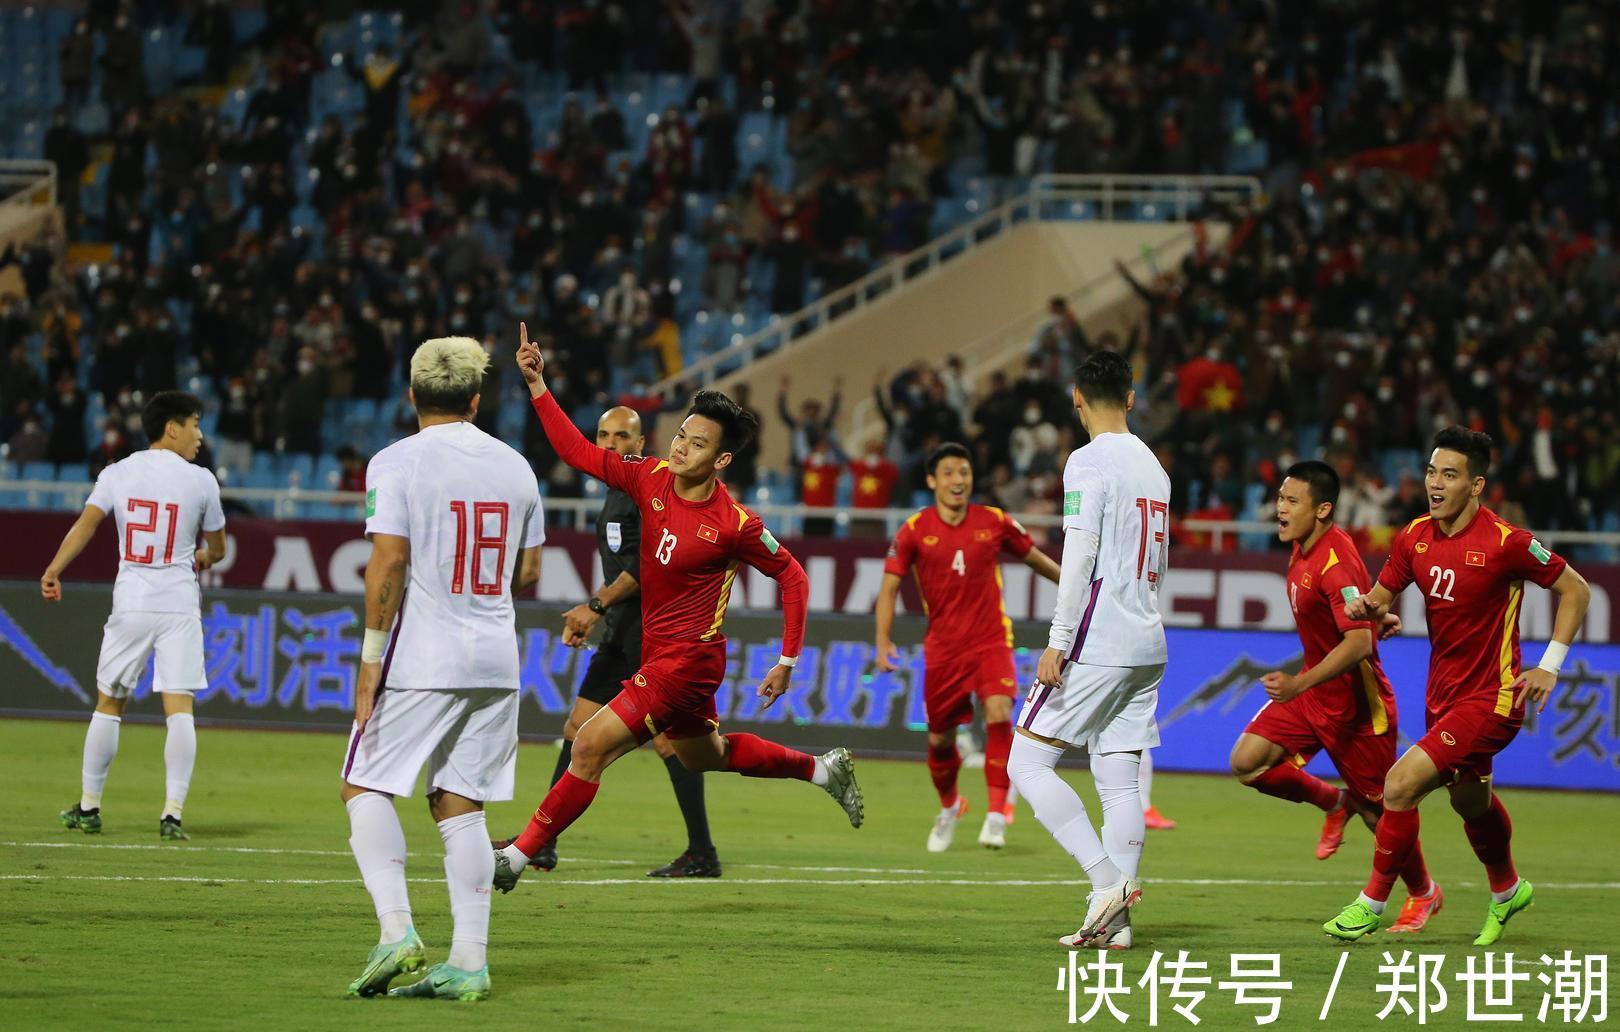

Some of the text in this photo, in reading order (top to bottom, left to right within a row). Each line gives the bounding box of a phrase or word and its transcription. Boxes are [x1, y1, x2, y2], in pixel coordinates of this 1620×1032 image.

[124, 498, 179, 564] 21
[449, 500, 509, 596] 18
[654, 527, 678, 566] 13
[951, 549, 966, 576] 4
[1429, 565, 1456, 602] 22
